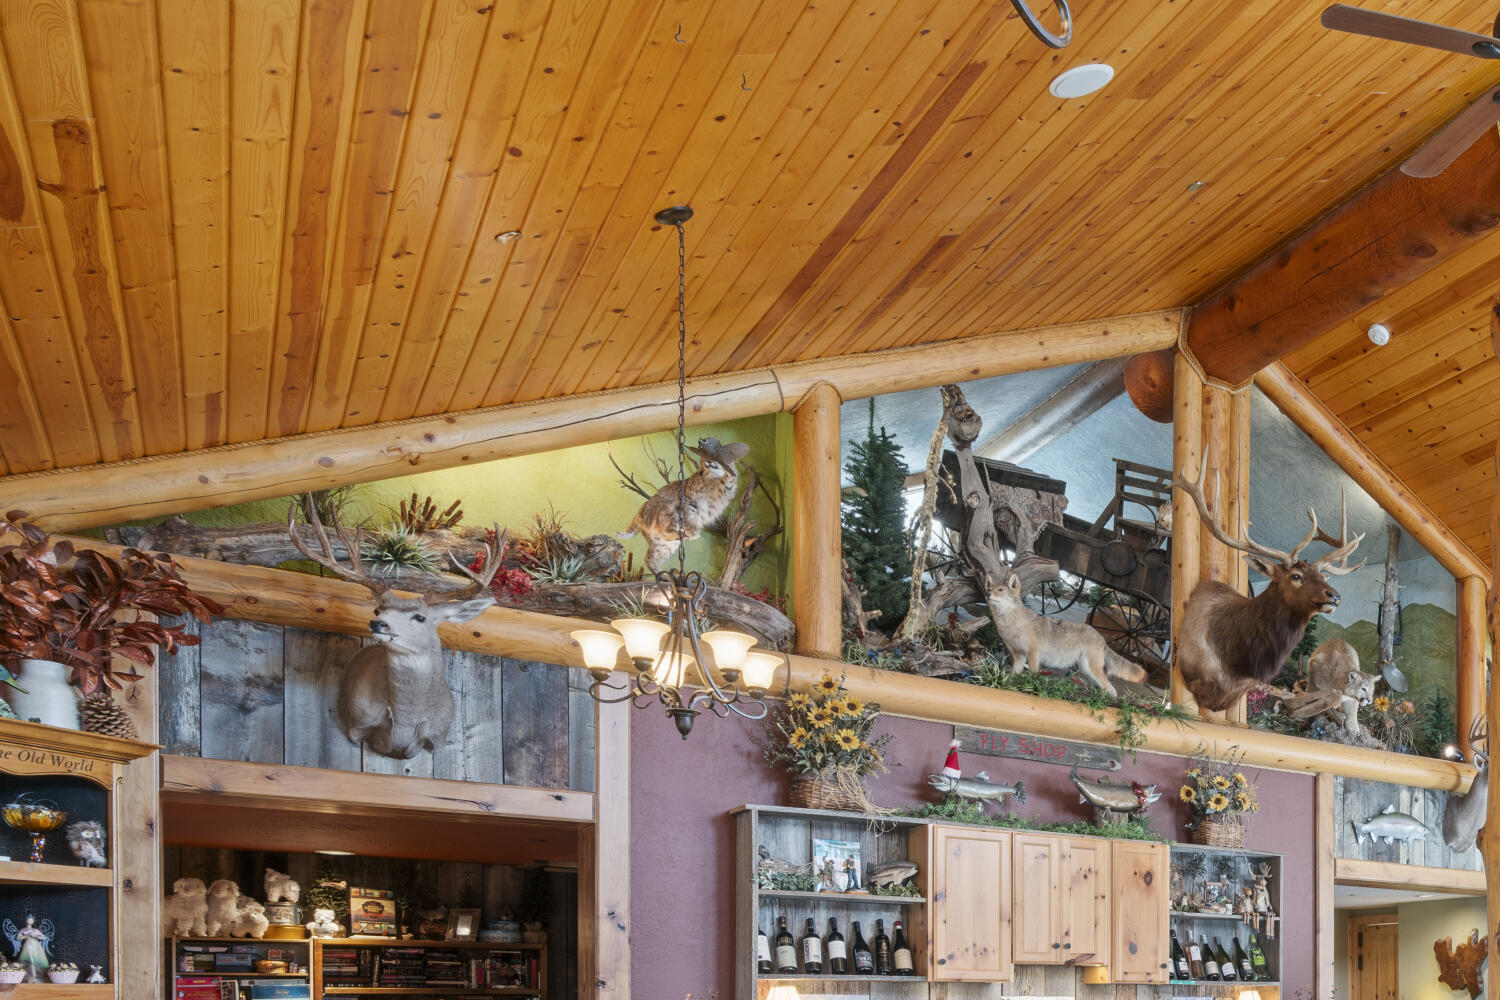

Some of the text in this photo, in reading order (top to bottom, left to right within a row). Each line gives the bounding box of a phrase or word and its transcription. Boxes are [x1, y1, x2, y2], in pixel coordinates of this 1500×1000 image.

[980, 733, 1068, 760] FLY SHOP
[17, 750, 46, 765] Old
[50, 754, 94, 772] World
